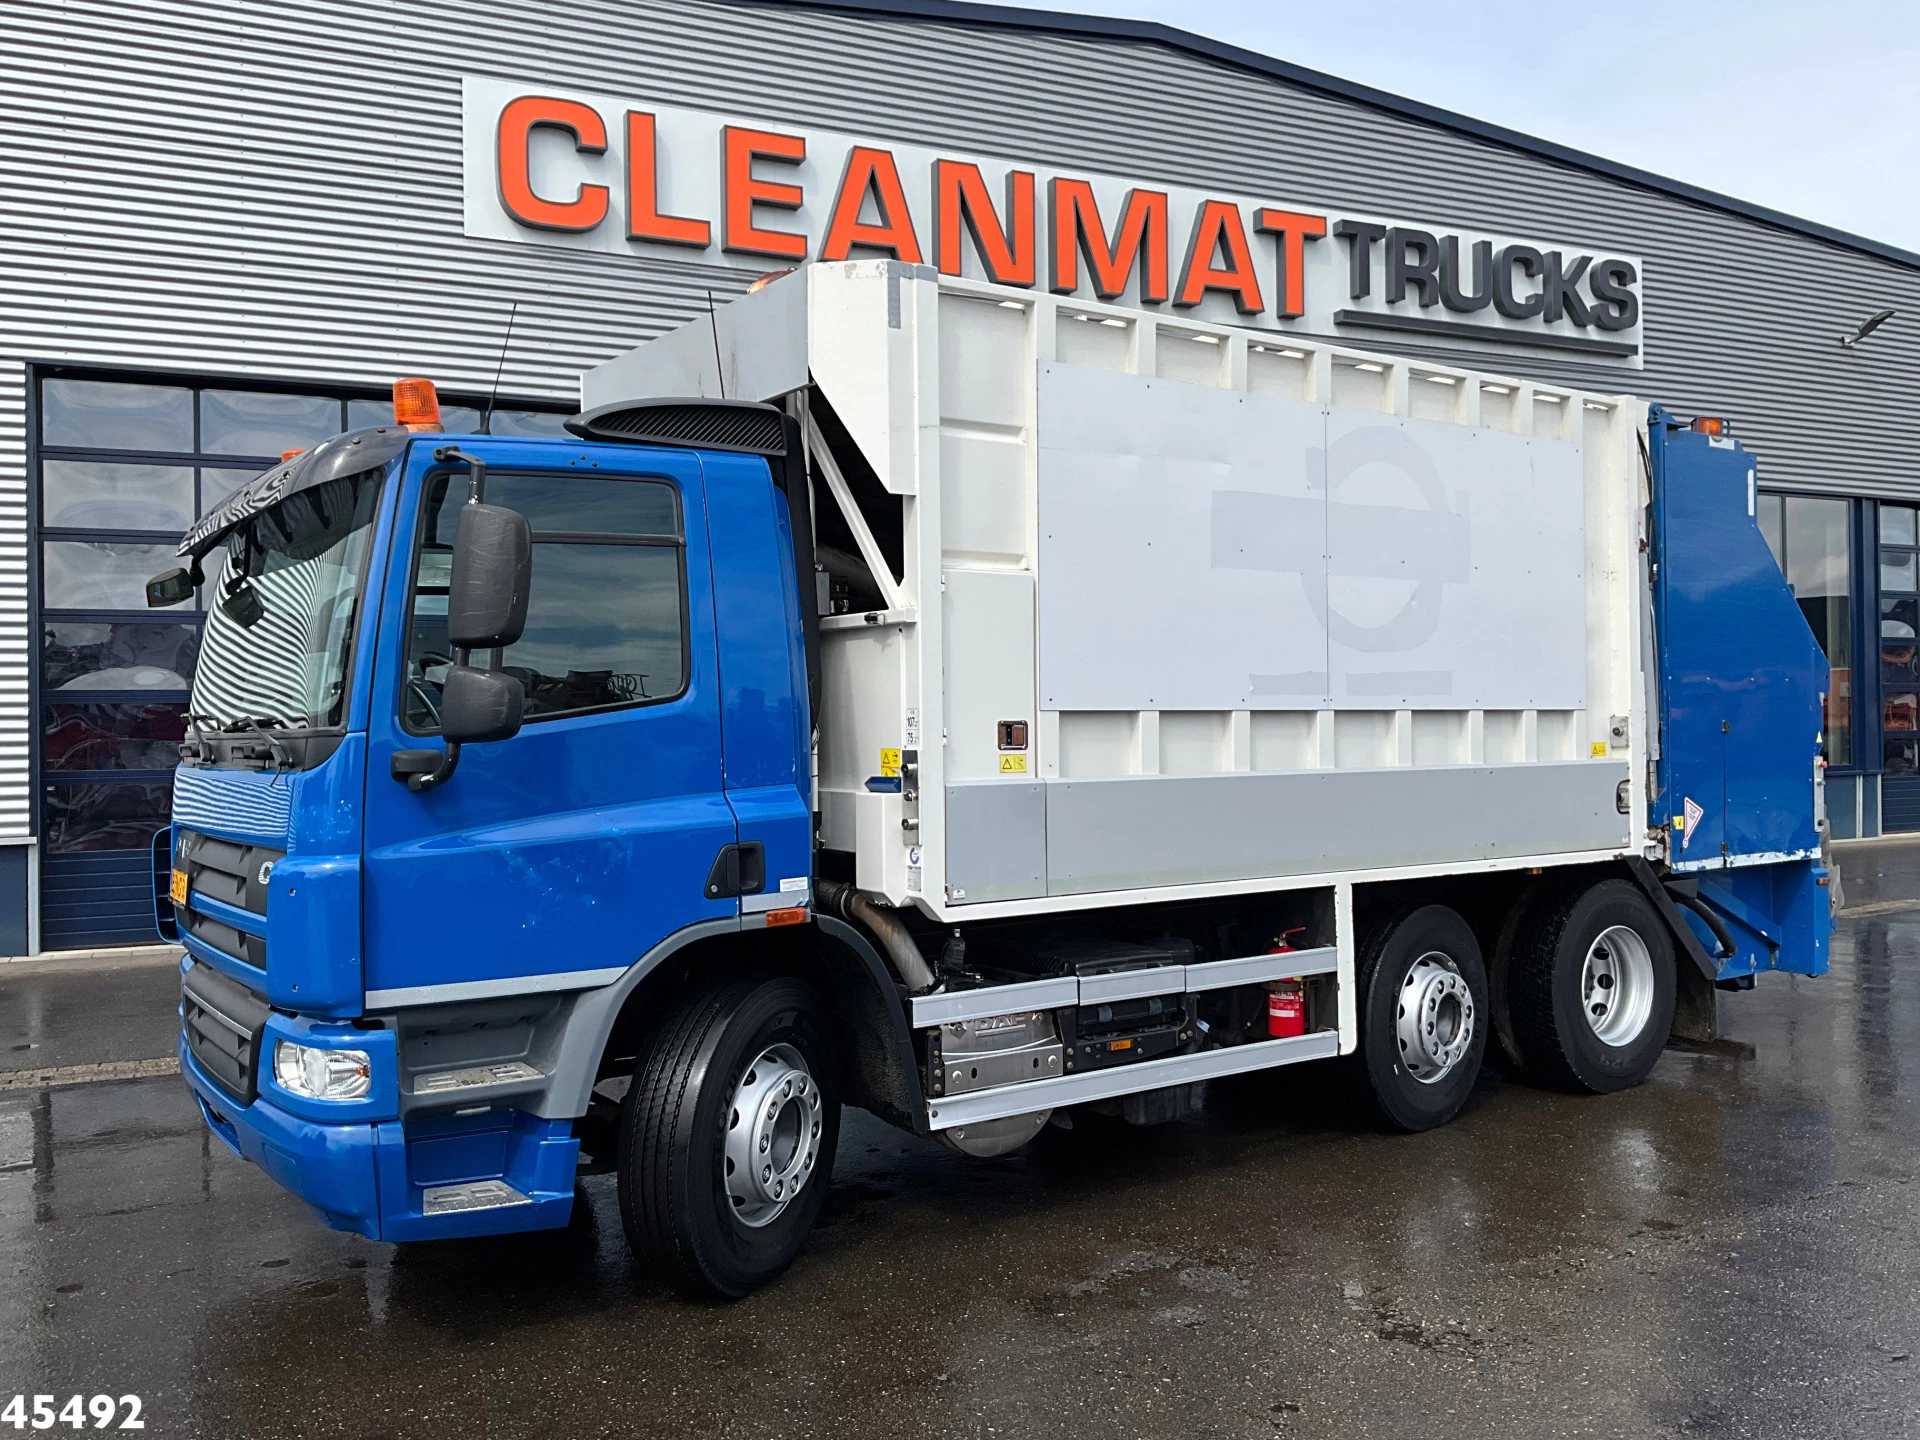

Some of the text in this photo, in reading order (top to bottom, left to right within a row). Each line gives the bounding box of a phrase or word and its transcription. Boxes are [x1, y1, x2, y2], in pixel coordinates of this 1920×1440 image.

[498, 95, 1639, 331] CLEANMAT TRUCKS
[975, 1013, 1026, 1031] DAF
